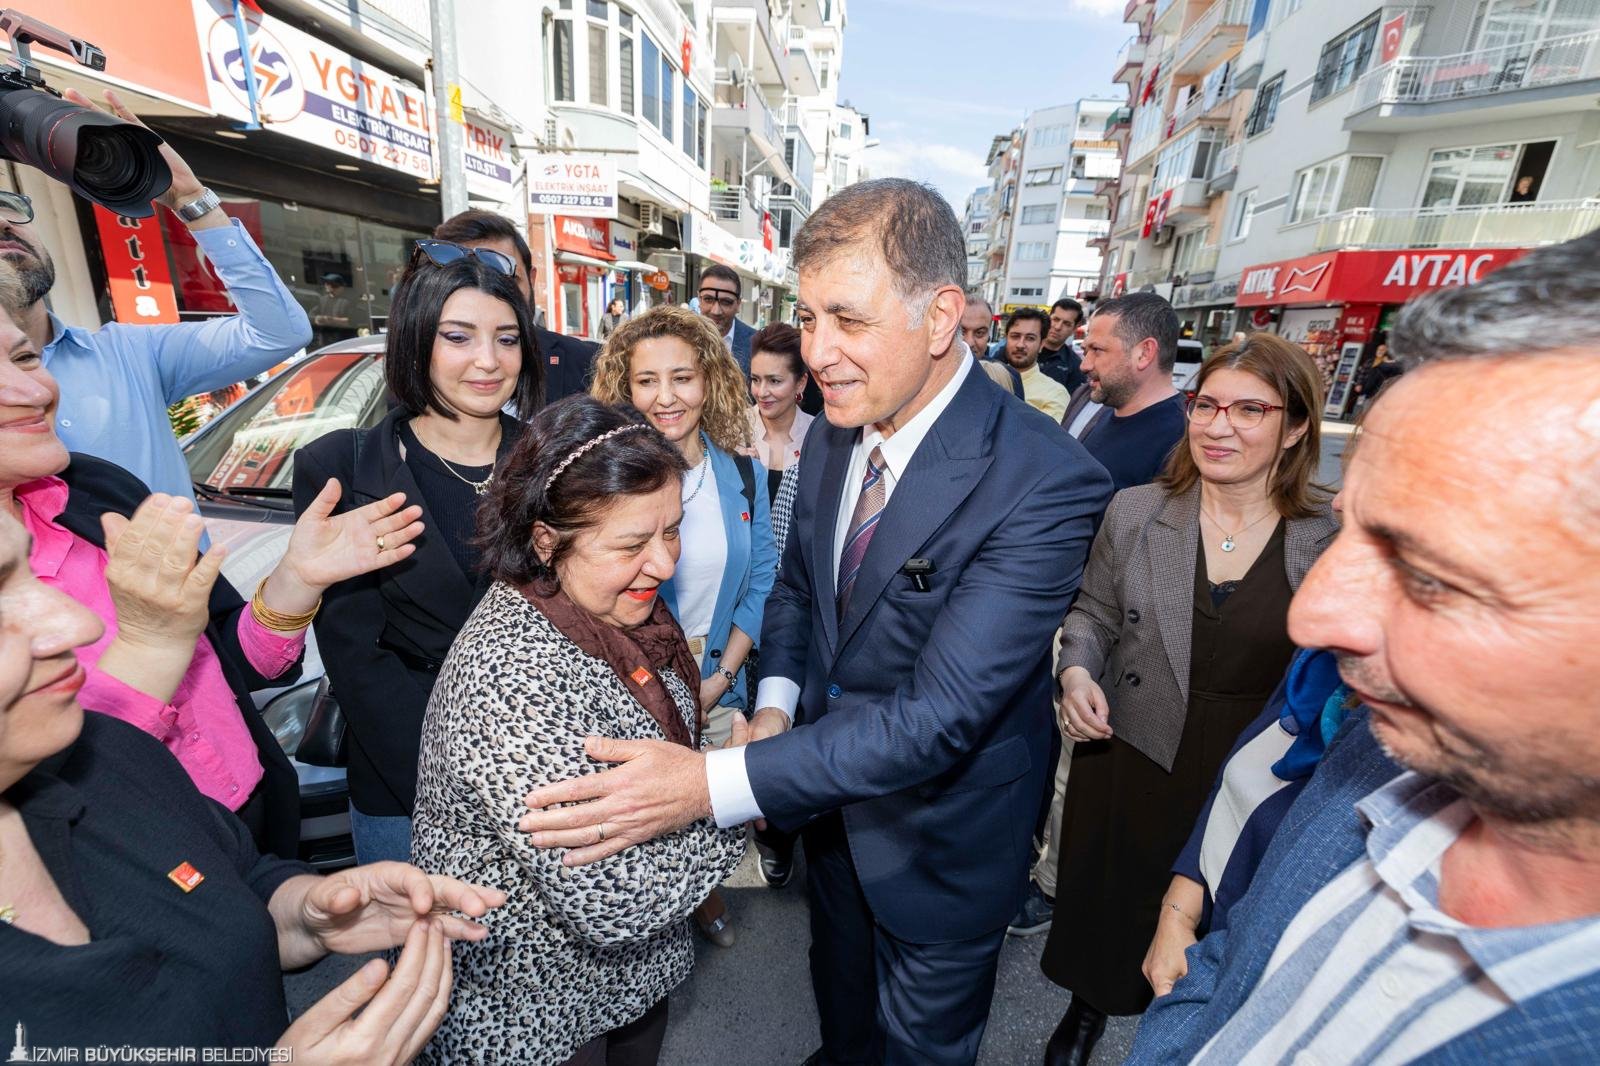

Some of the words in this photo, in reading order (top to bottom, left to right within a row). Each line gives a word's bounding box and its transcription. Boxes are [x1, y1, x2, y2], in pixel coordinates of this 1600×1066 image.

[309, 49, 398, 119] YGTA
[331, 103, 392, 141] ELEKTRİK
[335, 129, 377, 156] 0507
[382, 145, 408, 164] 227
[411, 155, 430, 172] 58
[564, 164, 600, 178] YGTA
[539, 194, 562, 204] 0507
[562, 195, 579, 205] 227
[580, 196, 592, 206] 58
[593, 197, 605, 206] 42
[562, 219, 605, 243] AKBANK
